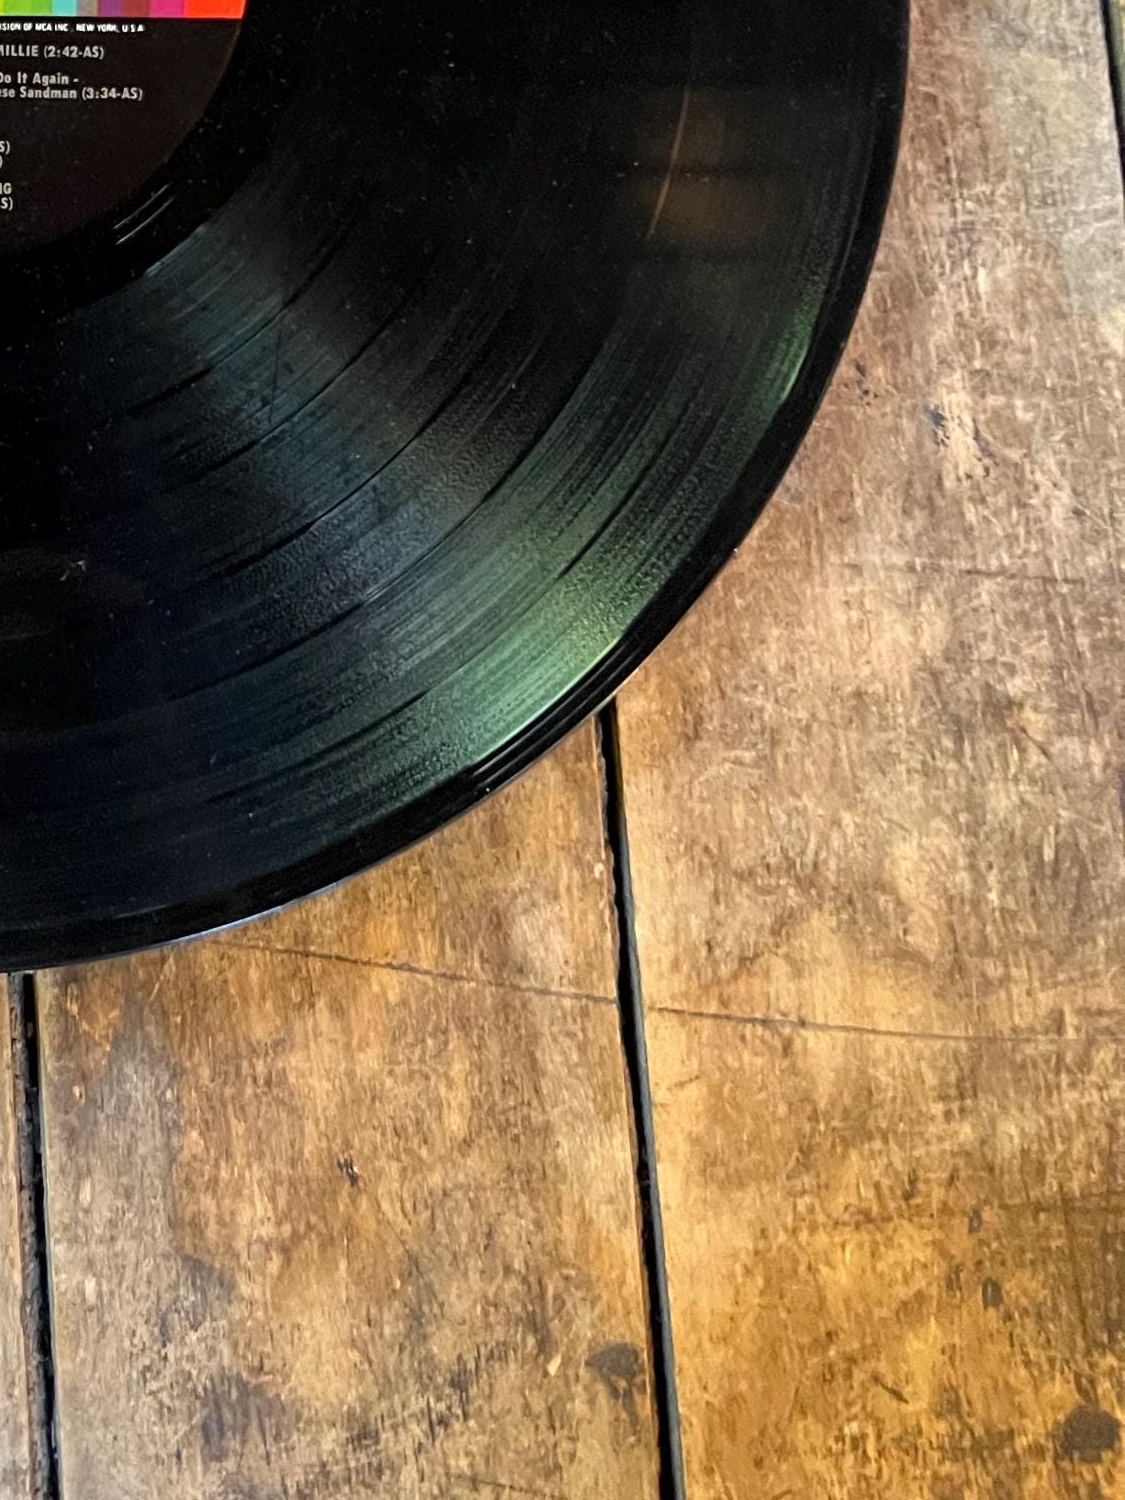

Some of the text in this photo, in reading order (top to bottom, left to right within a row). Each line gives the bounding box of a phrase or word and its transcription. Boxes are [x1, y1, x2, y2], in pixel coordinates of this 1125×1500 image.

[23, 23, 33, 31] OF
[35, 23, 52, 31] MCA
[43, 46, 104, 60] (2:42-AS)
[17, 73, 28, 84] It
[32, 73, 69, 86] Again
[19, 87, 77, 99] Sandman
[81, 87, 143, 101] (3:34-AS)
